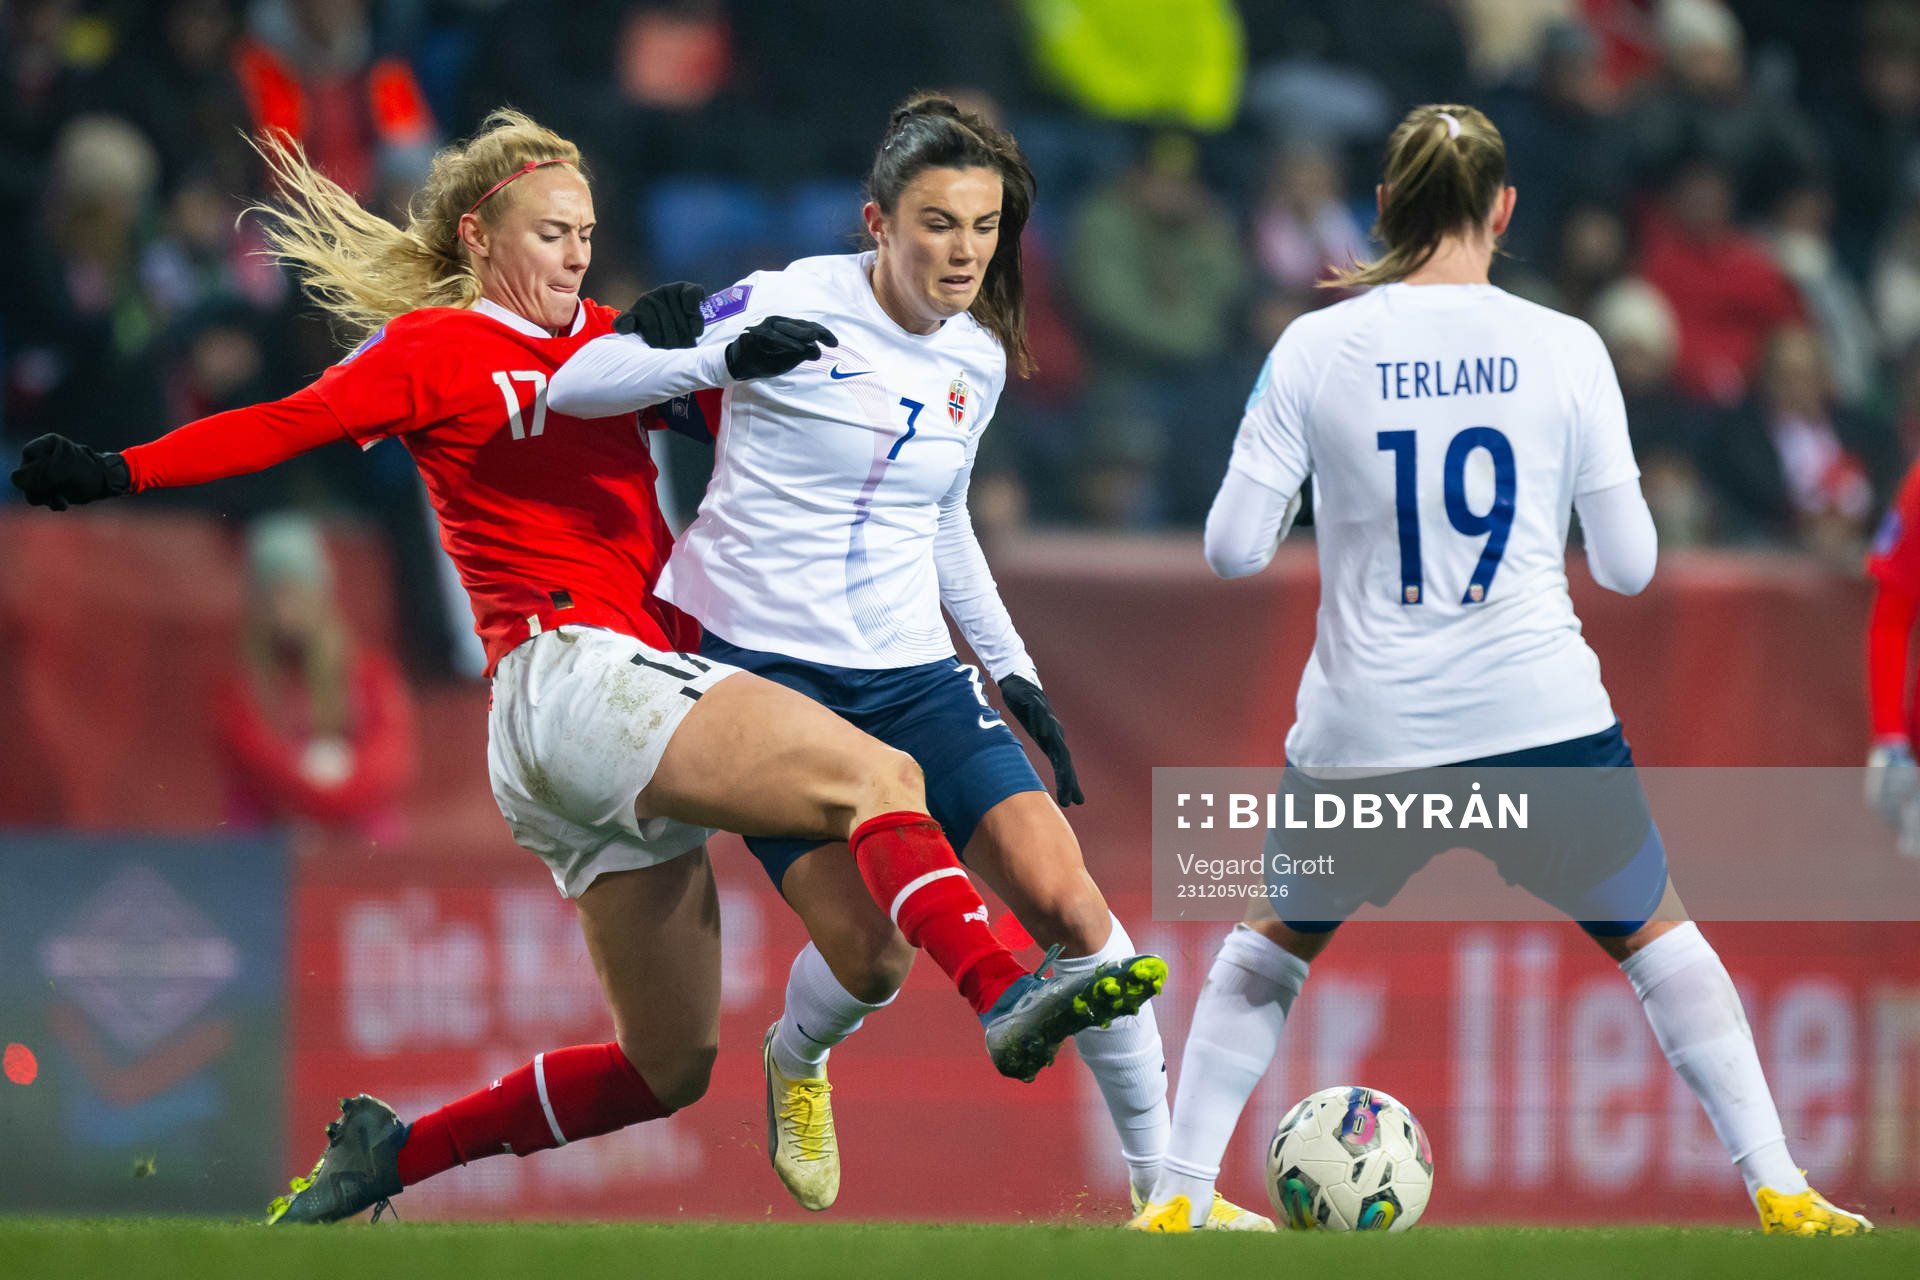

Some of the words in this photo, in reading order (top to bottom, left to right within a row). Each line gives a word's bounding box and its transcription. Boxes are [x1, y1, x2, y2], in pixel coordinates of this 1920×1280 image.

[492, 370, 547, 440] 17
[1376, 357, 1519, 399] TERLAND
[886, 396, 925, 461] 7
[1377, 426, 1516, 605] 19
